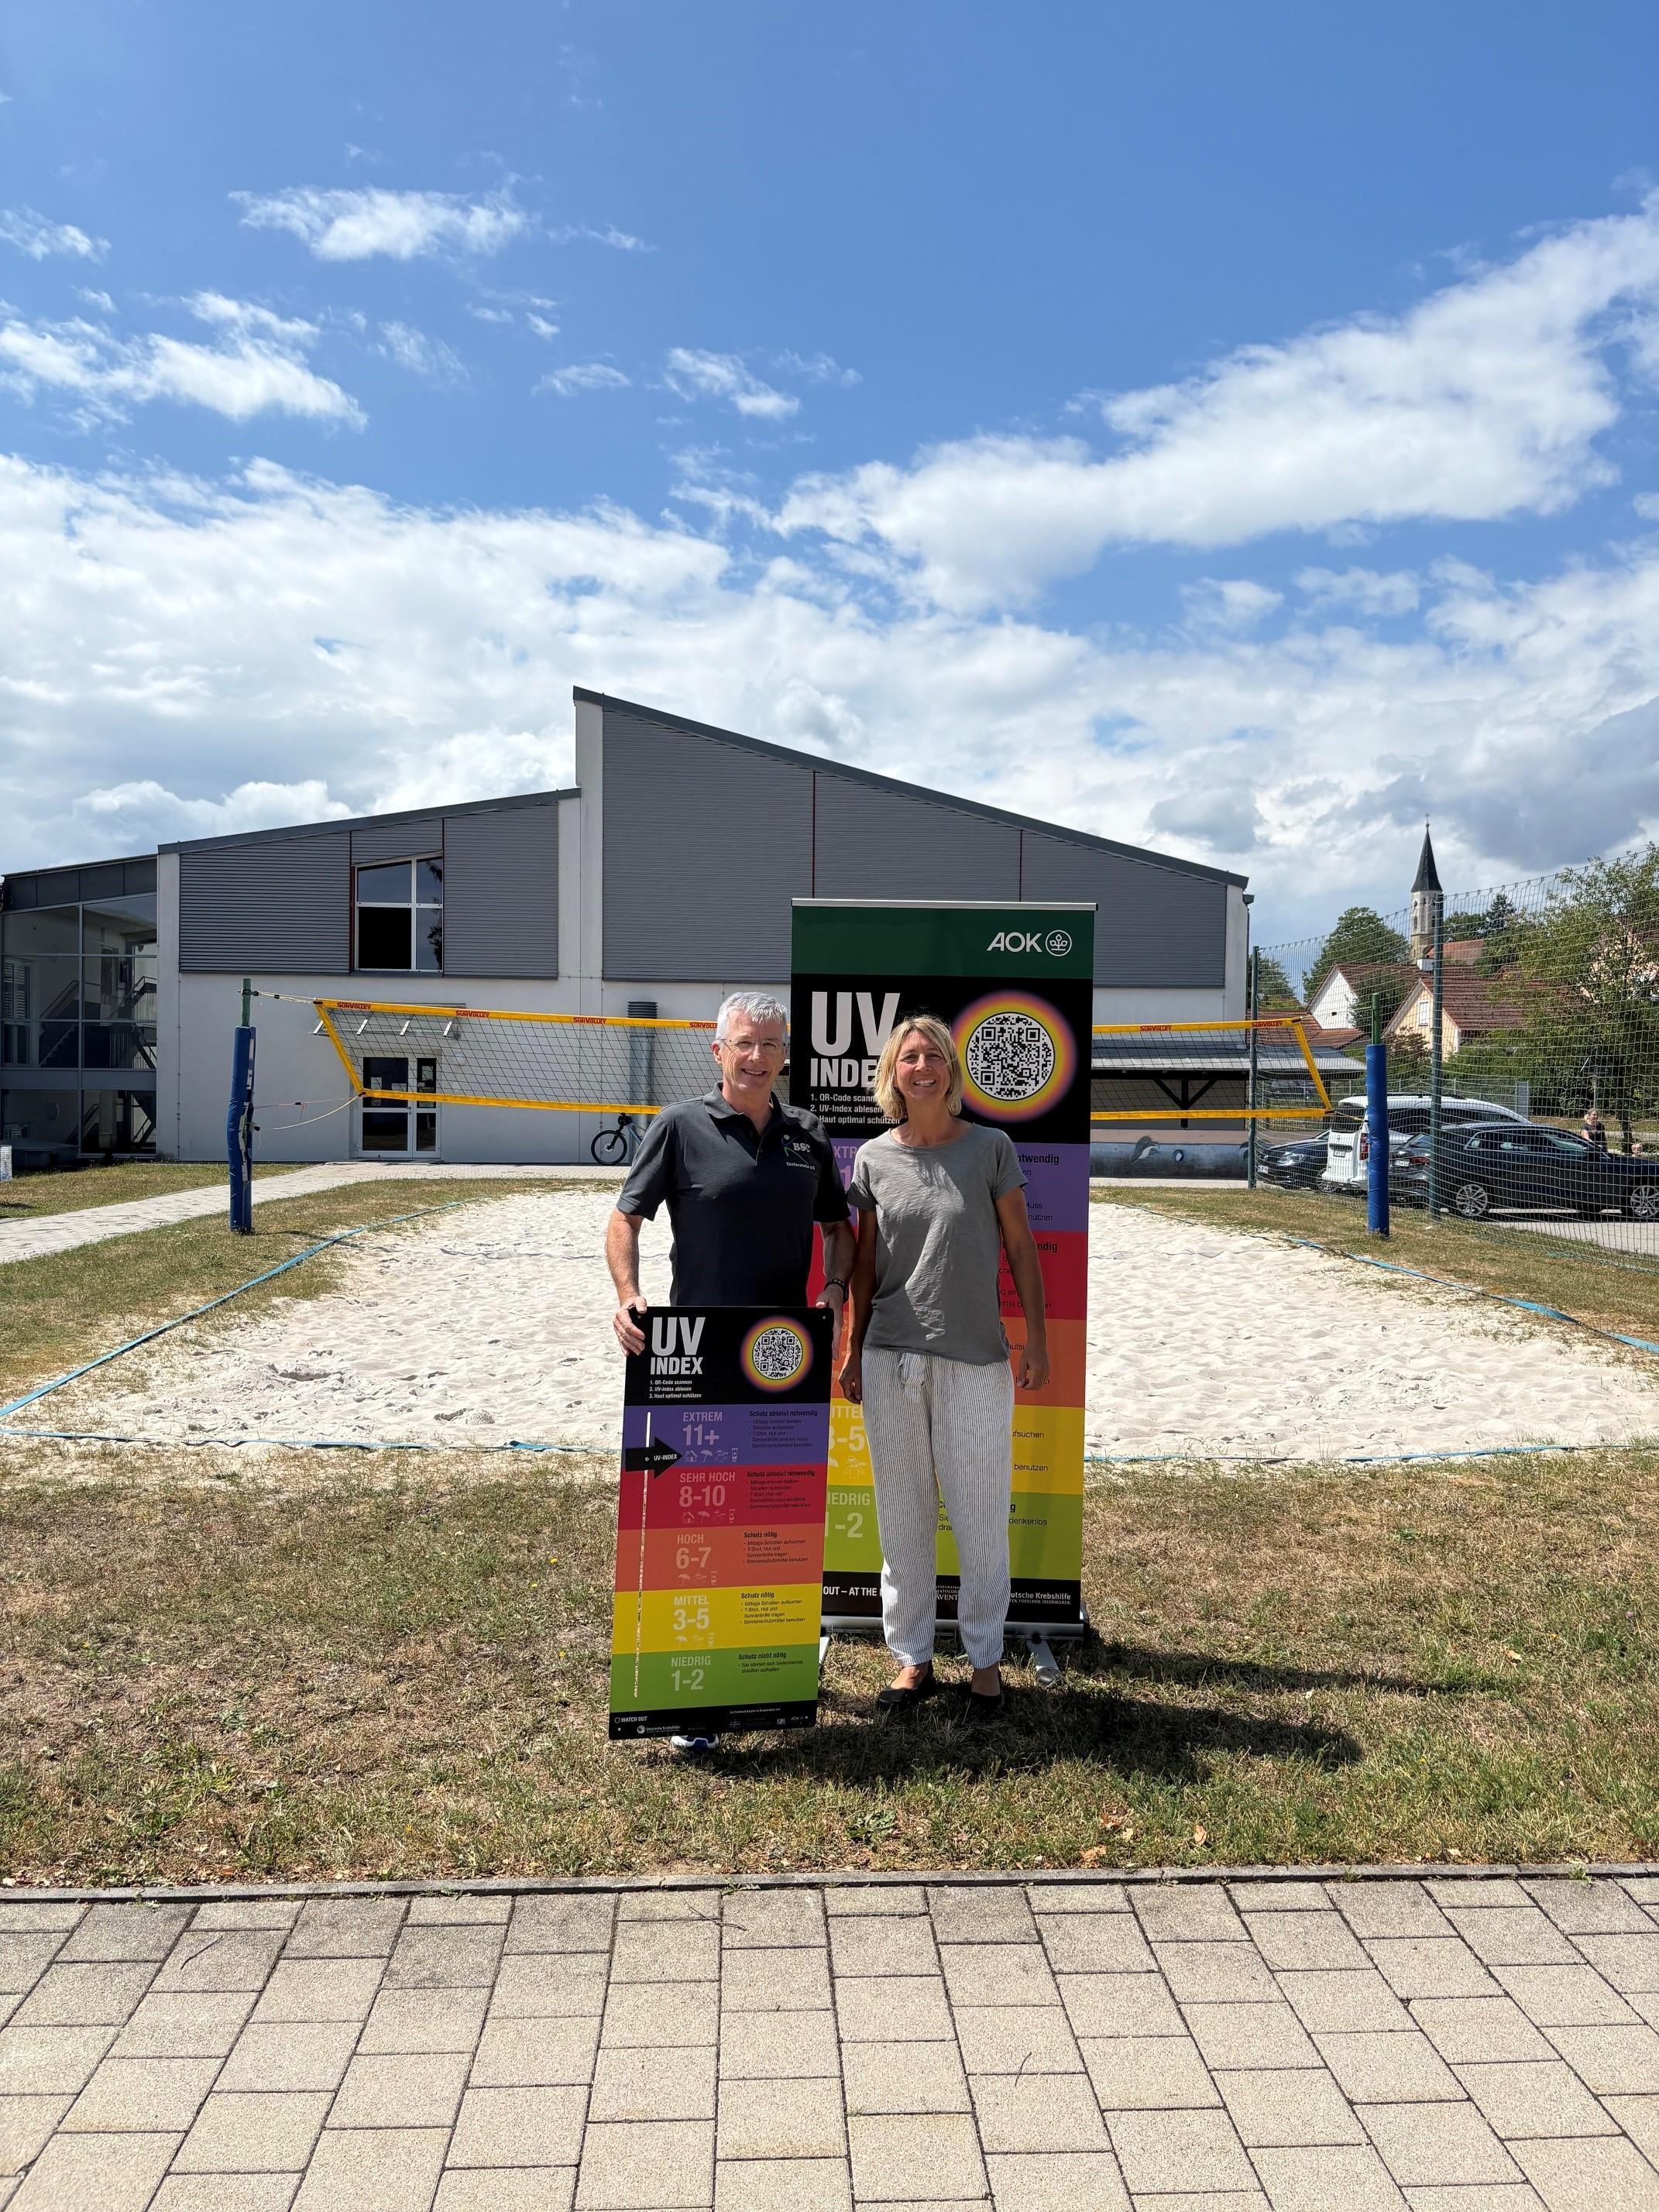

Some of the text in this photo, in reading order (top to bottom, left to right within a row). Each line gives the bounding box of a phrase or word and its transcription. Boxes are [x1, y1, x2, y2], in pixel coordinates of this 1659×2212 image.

[987, 932, 1042, 953] AOK
[811, 991, 901, 1056] UV
[810, 1058, 877, 1087] INDE
[838, 1116, 865, 1125] optimal
[792, 1142, 810, 1152] BSC
[651, 1317, 706, 1356] UV
[651, 1357, 703, 1375] INDEX
[682, 1412, 723, 1422] EXTREM
[682, 1424, 720, 1446] 11+
[1014, 1463, 1048, 1472] benutzen
[680, 1472, 735, 1482] SEHR HOCH
[679, 1485, 726, 1507] 8-10
[828, 1492, 871, 1506] IEDRIG
[1008, 1517, 1047, 1526] denkenlos
[677, 1534, 704, 1544] HOCH
[675, 1546, 711, 1569] 6-7
[823, 1585, 840, 1595] OUT
[849, 1587, 860, 1596] AT
[861, 1587, 878, 1596] THE
[674, 1595, 709, 1606] MITTEL
[672, 1607, 710, 1630] 3-5
[671, 1656, 711, 1667] NIEDRIG
[672, 1669, 704, 1692] 1-2
